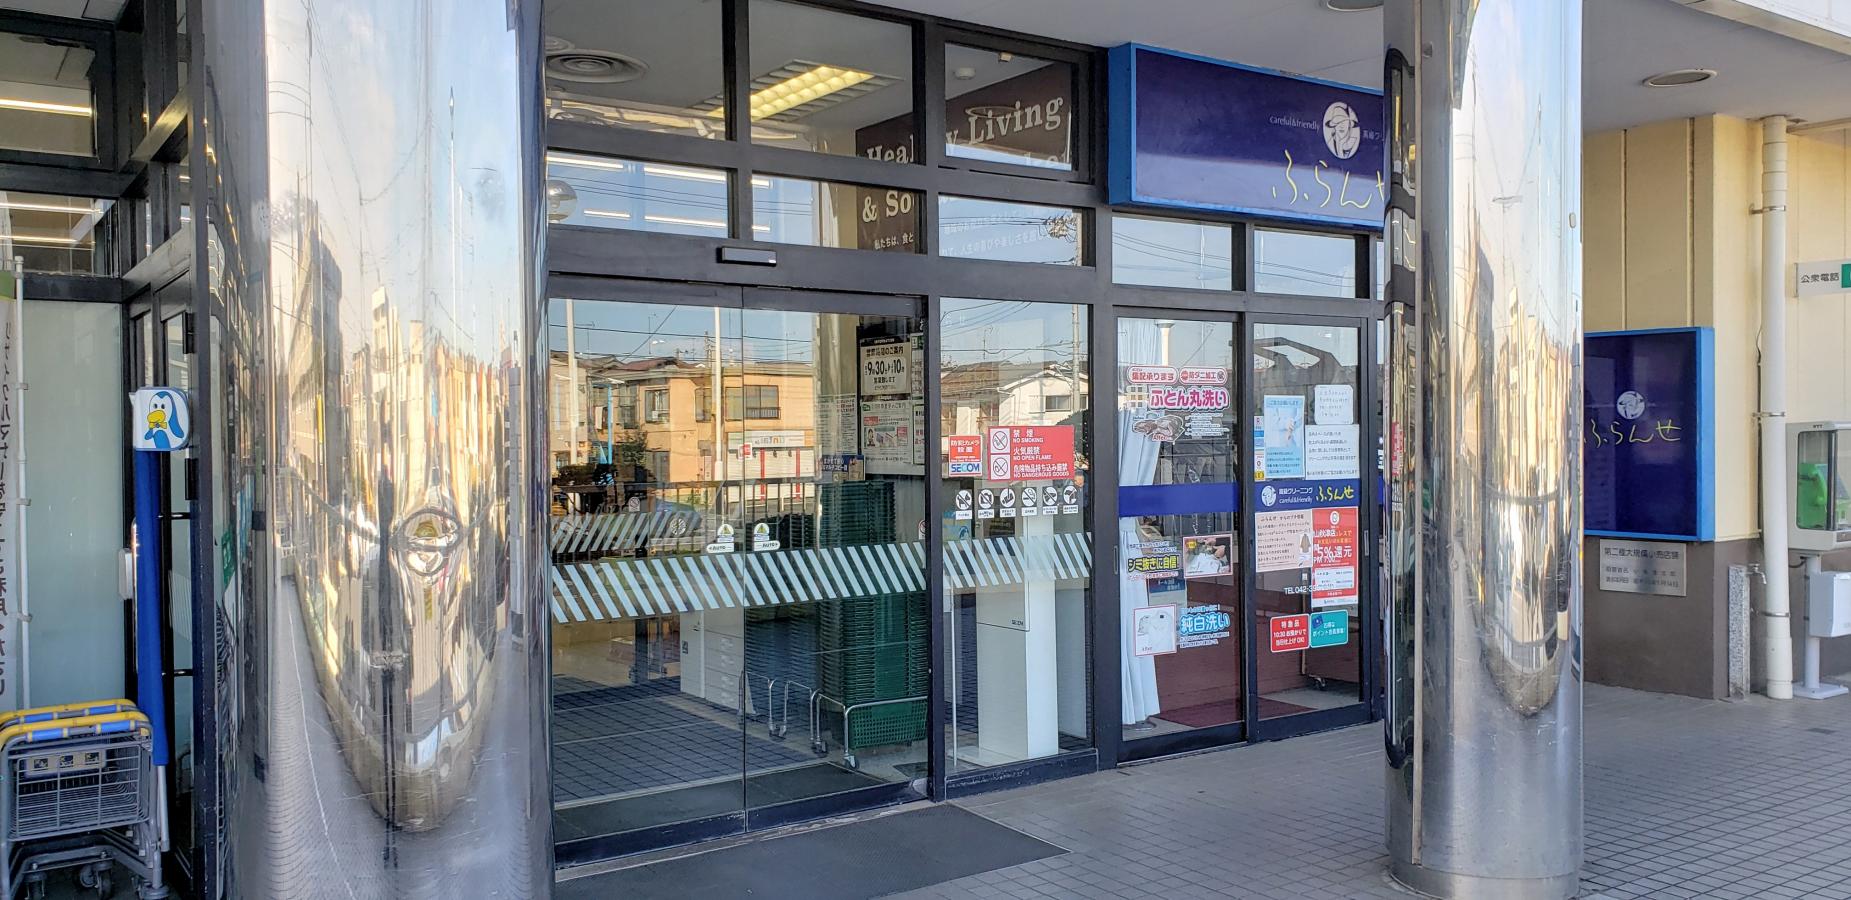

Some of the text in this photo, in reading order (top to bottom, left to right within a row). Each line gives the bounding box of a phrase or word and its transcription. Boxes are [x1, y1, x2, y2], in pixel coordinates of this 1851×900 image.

[968, 97, 1064, 146] Living
[862, 196, 878, 222] &
[1801, 272, 1840, 284] 公衆電話
[1150, 388, 1228, 408] ふとん丸洗い
[1584, 419, 1682, 448] ふらんせ
[1013, 446, 1041, 456] 火気厳禁
[950, 463, 980, 473] SECOM
[1315, 485, 1354, 502] ふらんせ
[1284, 587, 1295, 595] TEL
[1181, 613, 1230, 633] 純白洗い
